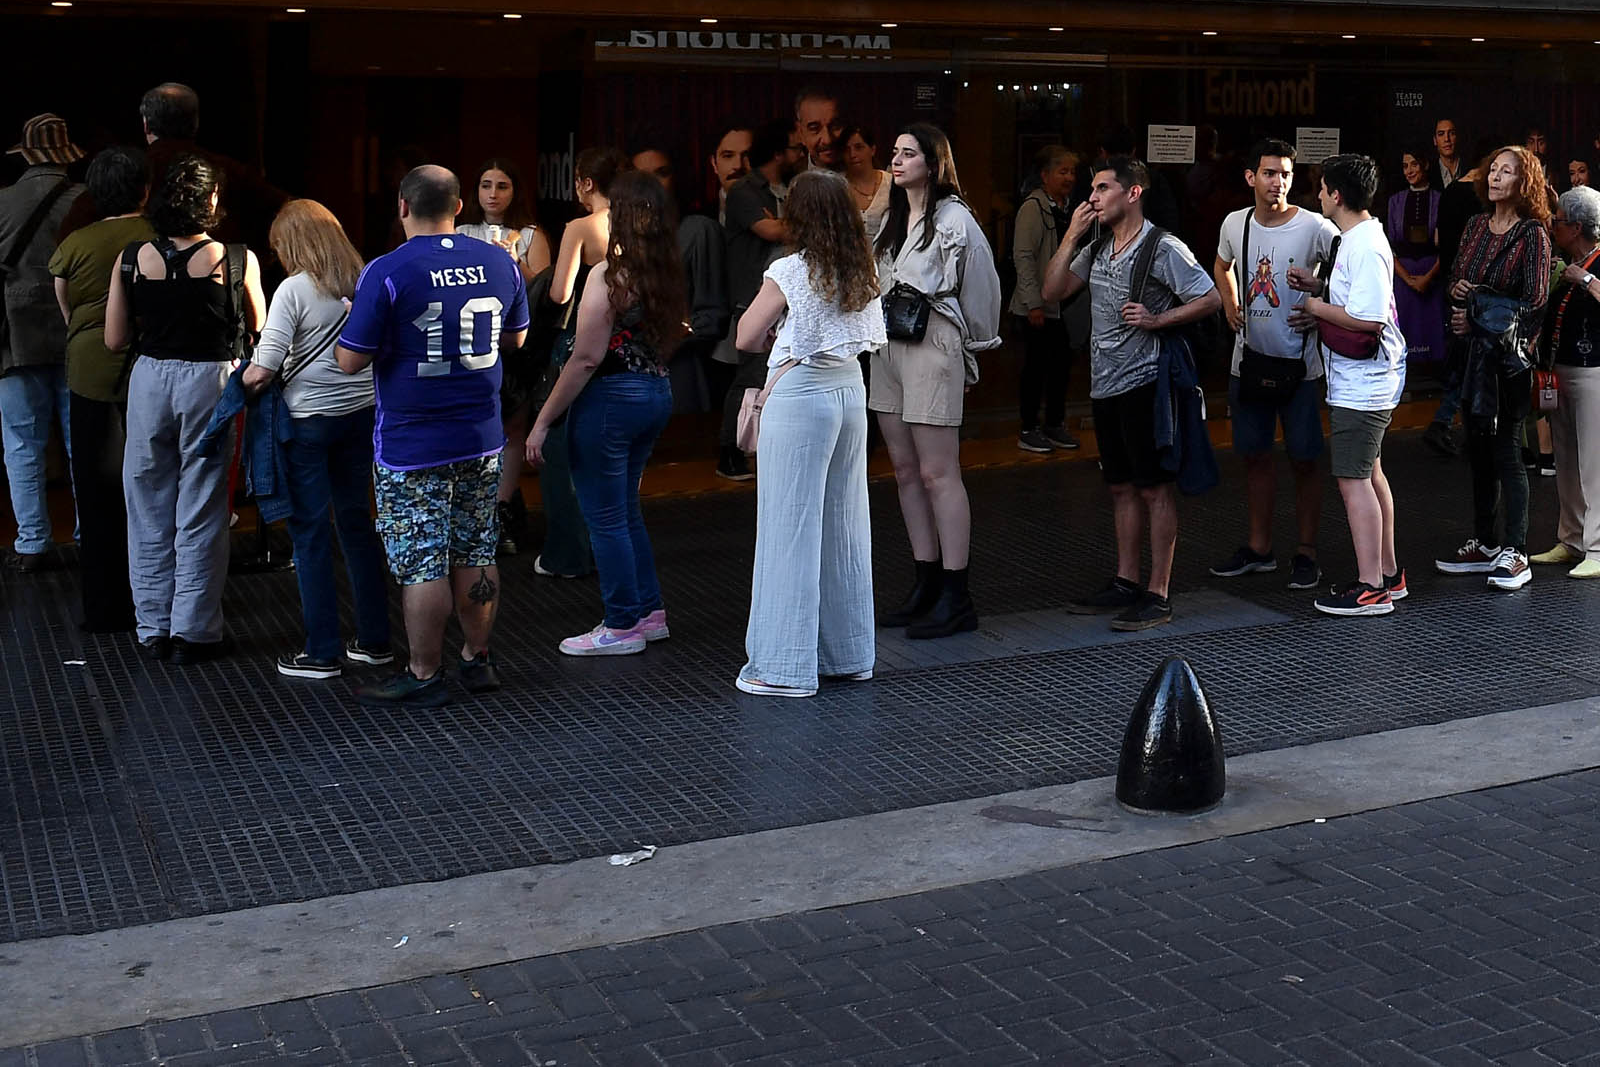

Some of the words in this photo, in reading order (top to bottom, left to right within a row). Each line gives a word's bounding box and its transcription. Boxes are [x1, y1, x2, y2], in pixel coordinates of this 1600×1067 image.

[1206, 61, 1316, 118] Edmond
[1395, 92, 1423, 100] TEATRO
[1395, 99, 1423, 107] ALVEAR
[430, 265, 488, 288] MESSI
[411, 296, 503, 378] 10
